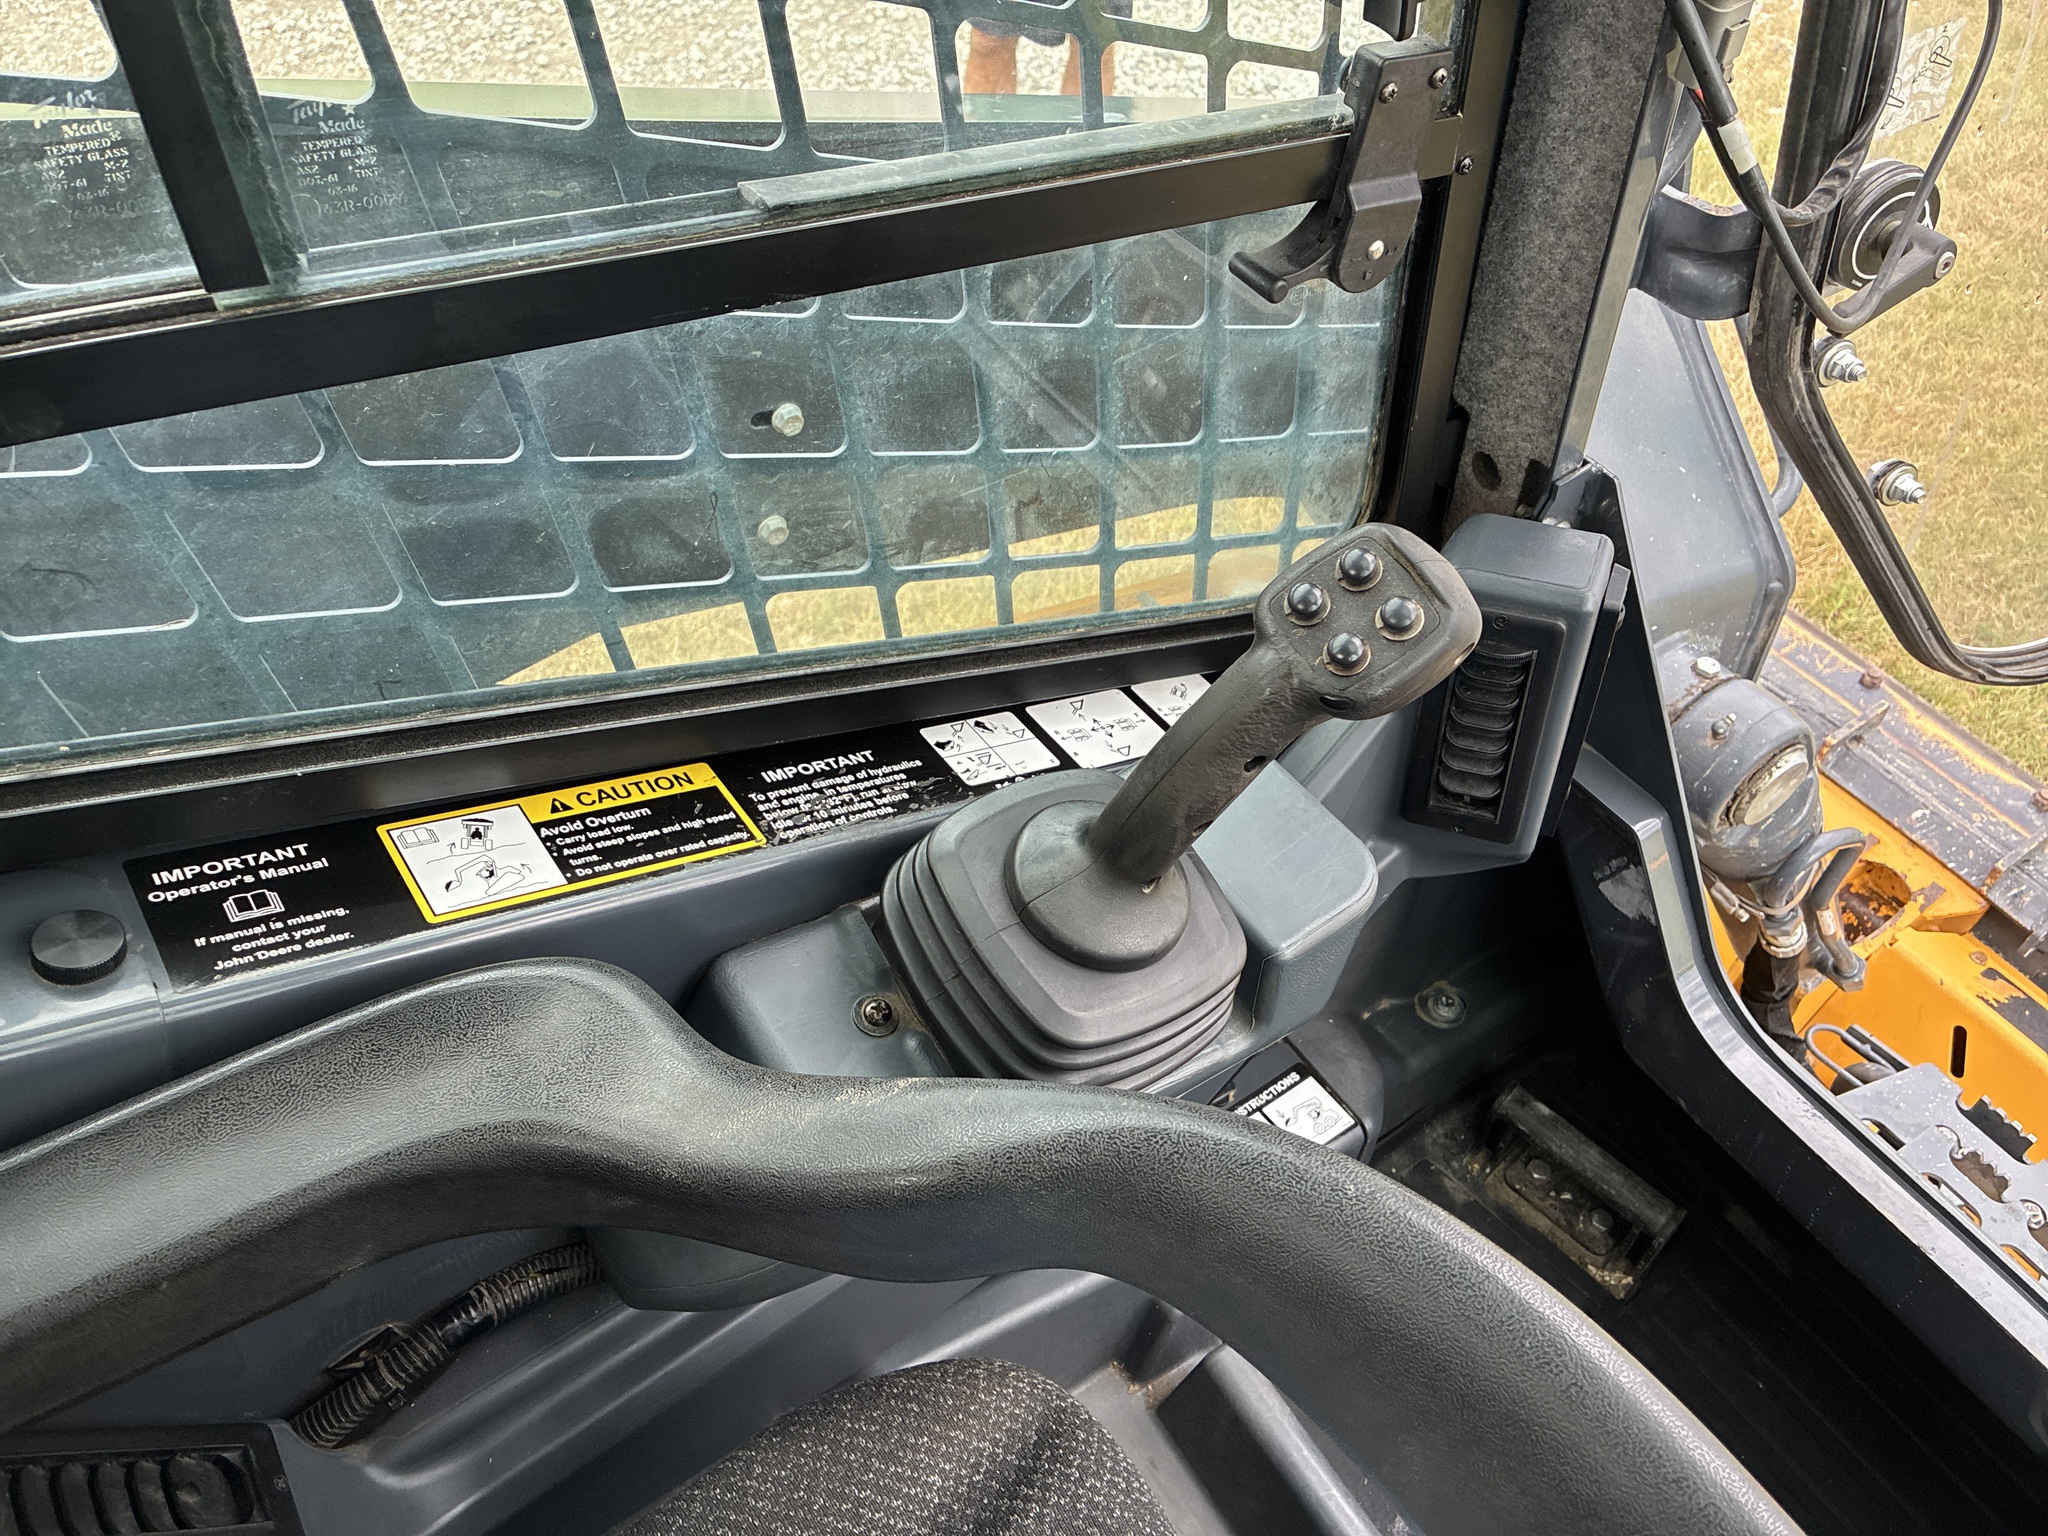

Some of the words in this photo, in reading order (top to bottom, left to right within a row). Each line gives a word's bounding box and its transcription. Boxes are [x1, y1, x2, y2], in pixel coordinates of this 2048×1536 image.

[61, 120, 113, 138] Made
[318, 117, 365, 134] Made
[34, 155, 83, 170] SAFETY
[87, 147, 130, 161] GLASS
[43, 137, 111, 155] TEMPERED
[291, 150, 335, 164] SAFETY
[340, 145, 377, 158] GLASS
[302, 136, 363, 151] TEMPERED
[104, 159, 129, 171] M-2
[104, 170, 131, 182] TINT
[297, 165, 319, 176] AS2
[354, 157, 377, 166] M-2
[298, 173, 338, 186] DOT-61
[354, 168, 378, 178] TINT
[748, 793, 766, 803] To
[766, 783, 811, 800] prevent
[811, 774, 855, 790] damage
[856, 770, 868, 779] of
[868, 760, 923, 776] hydraulics
[761, 750, 875, 783] IMPORTANT
[575, 771, 695, 807] CAUTION
[757, 800, 780, 811] and
[823, 786, 836, 796] in
[836, 773, 907, 794] temperatures
[762, 807, 799, 820] below
[860, 789, 880, 799] run
[540, 820, 584, 839] Avoid
[585, 806, 652, 829] Overturn
[770, 819, 794, 830] idle
[812, 810, 829, 820] 10
[830, 801, 874, 817] minutes
[873, 792, 910, 806] before
[779, 820, 833, 839] operation
[833, 814, 848, 827] of
[849, 806, 897, 822] controls.
[556, 832, 586, 847] Carry
[588, 827, 611, 839] load
[613, 823, 635, 834] low.
[563, 843, 594, 857] Avoid
[595, 836, 625, 852] steep
[626, 828, 661, 844] slopes
[663, 822, 681, 833] and
[682, 817, 706, 830] high
[706, 811, 737, 826] speed
[151, 843, 308, 885] IMPORTANT
[569, 854, 603, 867] turns.
[575, 865, 593, 878] Do
[594, 861, 613, 873] not
[614, 853, 655, 870] operate
[655, 847, 678, 858] over
[680, 839, 705, 853] rated
[706, 829, 751, 847] capacity.
[147, 874, 256, 902] Operator's
[258, 857, 330, 880] Manual
[194, 937, 207, 947] If
[209, 923, 267, 946] manual
[269, 920, 285, 931] is
[286, 905, 350, 928] missing,
[231, 932, 290, 952] contact
[291, 923, 327, 941] your
[213, 954, 255, 971] John
[253, 942, 302, 961] Deere
[305, 930, 355, 950] dealer.
